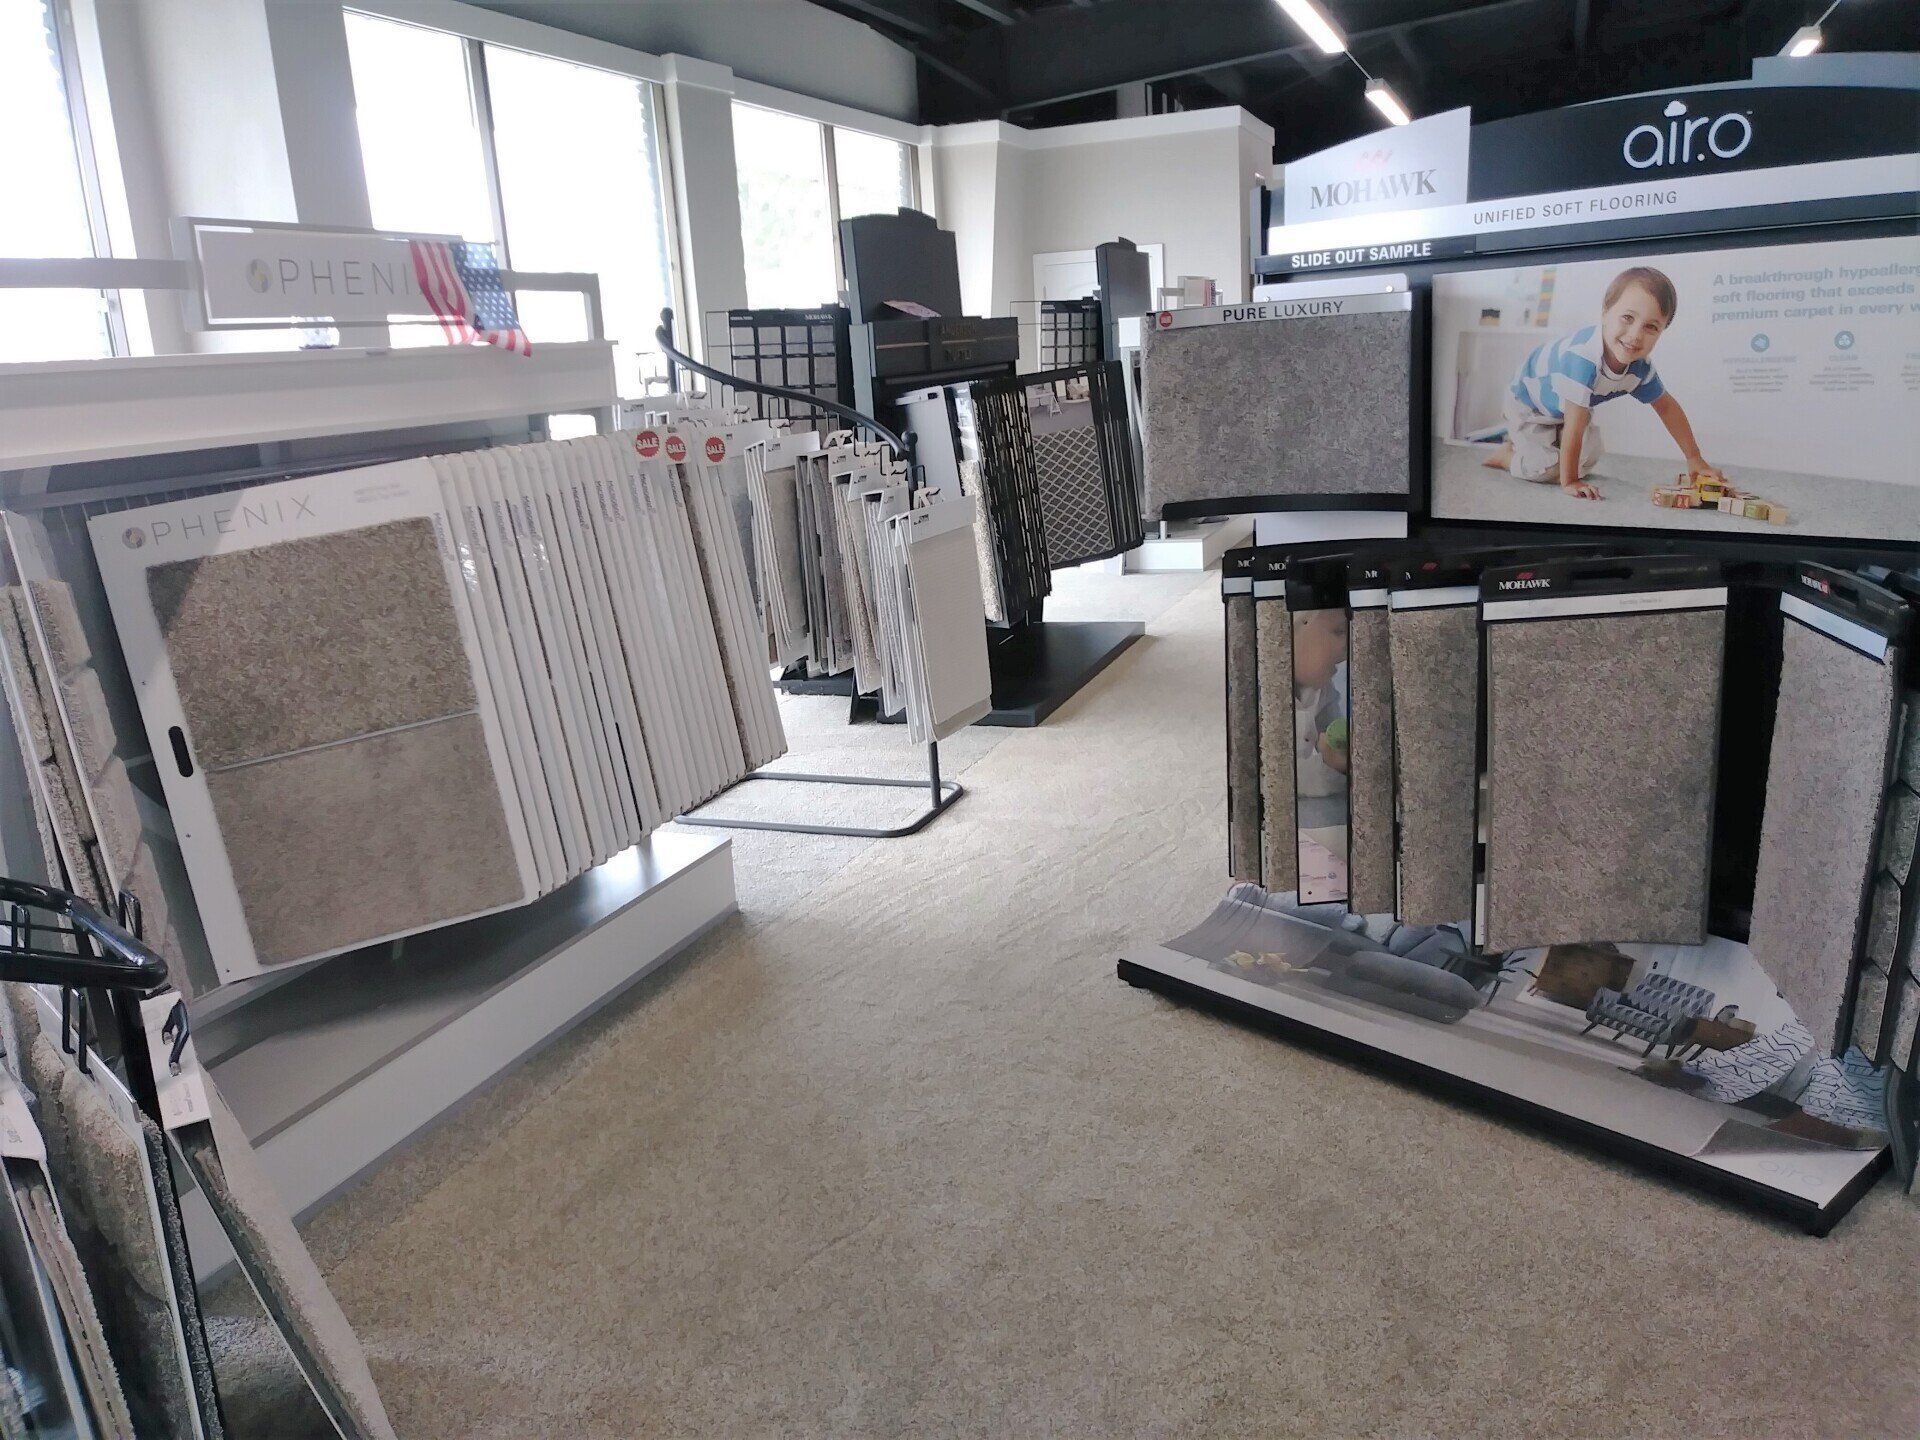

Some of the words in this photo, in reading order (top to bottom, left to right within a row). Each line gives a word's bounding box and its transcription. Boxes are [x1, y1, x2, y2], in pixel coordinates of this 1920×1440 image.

[1310, 168, 1437, 210] MOHAWK
[1474, 206, 1535, 225] UNIFIED
[1542, 201, 1583, 217] SOFT
[1590, 190, 1677, 212] FLOORING
[1291, 253, 1331, 269] SLIDE
[1335, 249, 1365, 265] OUT
[1369, 242, 1432, 261] SAMPLE
[279, 258, 424, 296] PHENI
[1712, 273, 1724, 287] A
[1729, 267, 1833, 284] breakthrough
[1712, 290, 1742, 303] soft
[1746, 288, 1805, 303] flooring
[1810, 286, 1842, 298] that
[1848, 281, 1915, 298] exceeds
[1223, 306, 1267, 322] PURE
[1274, 300, 1344, 318] LUXURY
[1711, 307, 1778, 323] premium
[1784, 304, 1834, 319] carpet
[1840, 303, 1853, 315] in
[1859, 303, 1904, 315] every
[636, 438, 659, 449] SALE
[667, 443, 686, 454] SALE
[706, 443, 725, 455] SALE
[151, 494, 317, 546] PHENIX
[1499, 578, 1551, 591] MOHAWK
